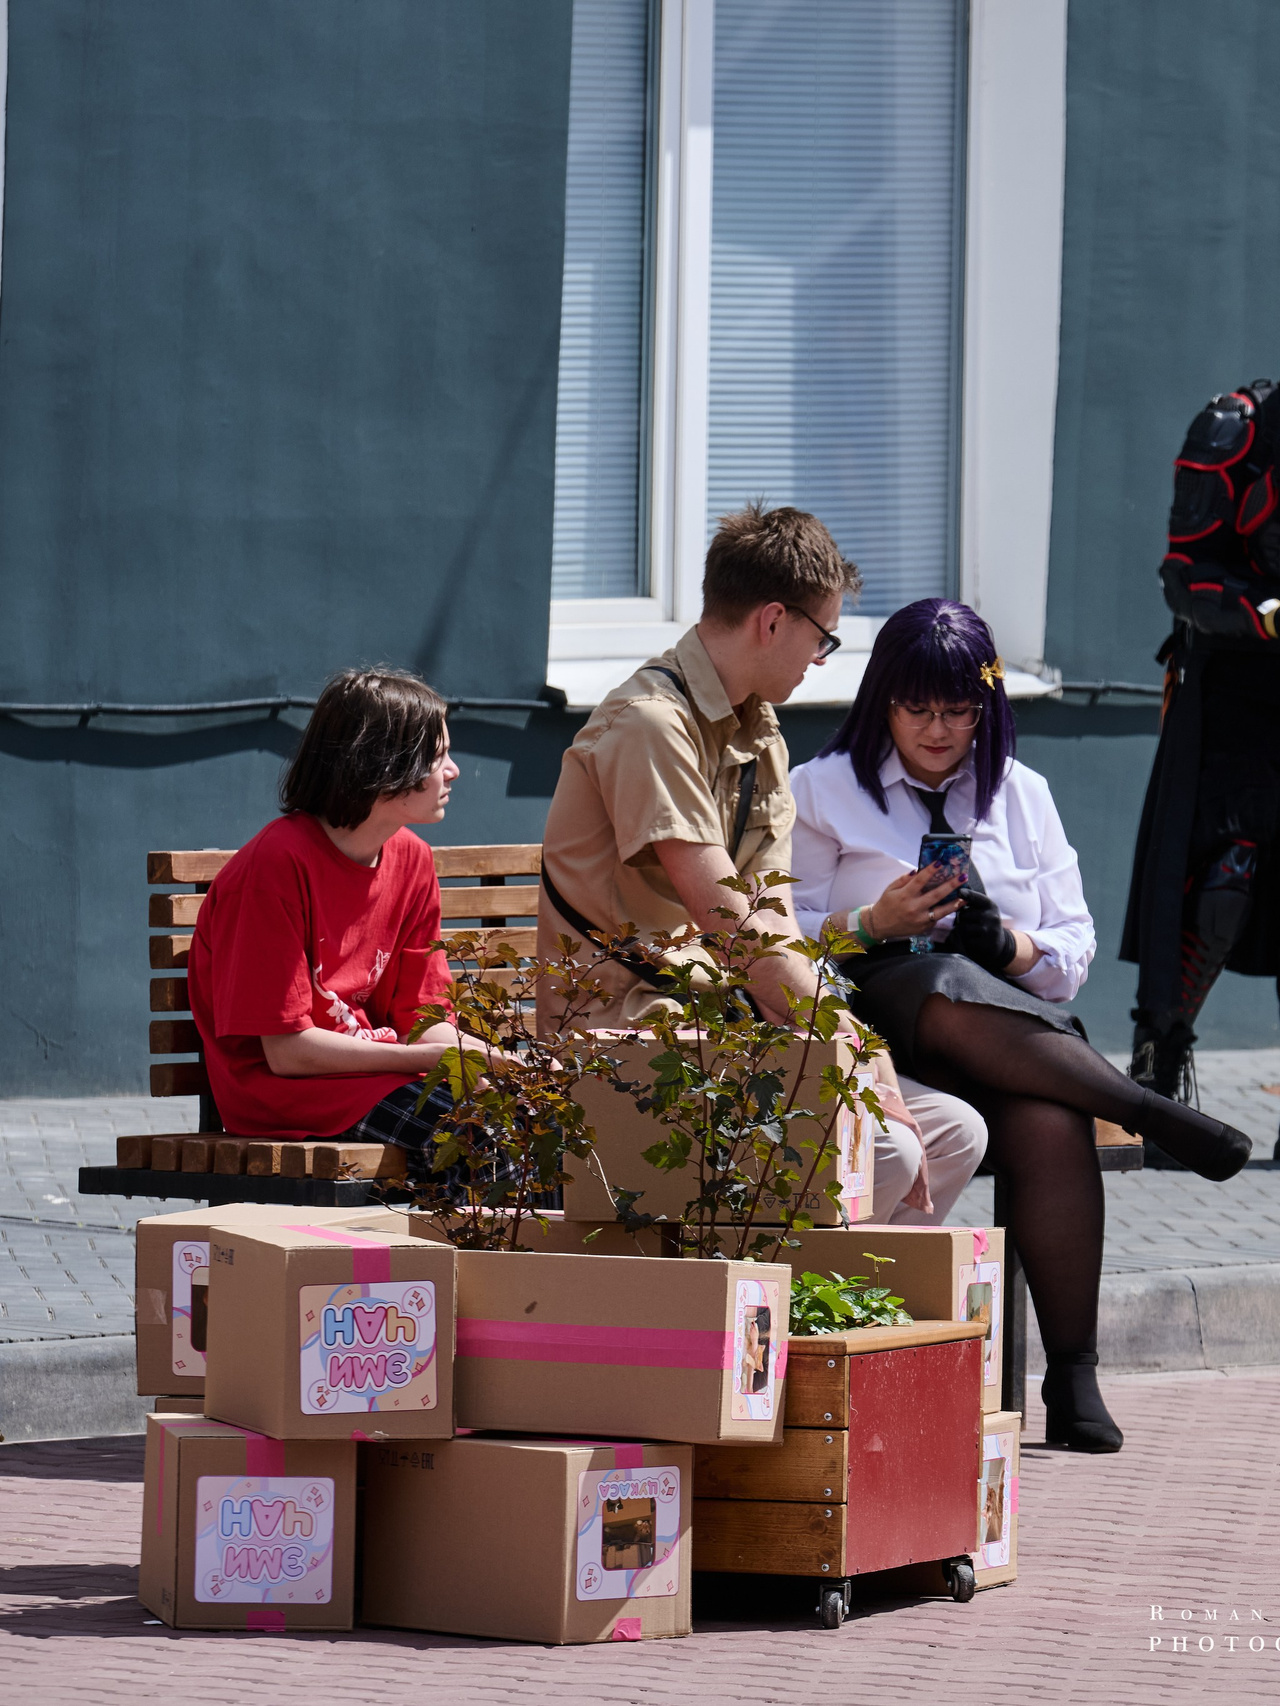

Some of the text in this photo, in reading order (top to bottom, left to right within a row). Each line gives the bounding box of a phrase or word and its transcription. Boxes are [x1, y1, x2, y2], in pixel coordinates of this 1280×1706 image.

[323, 1305, 417, 1346] ЧАН
[329, 1353, 409, 1389] ЭМИ
[599, 1481, 658, 1498] ЦУКАСА
[221, 1499, 314, 1537] ЧАН
[224, 1546, 304, 1580] ЭМИ
